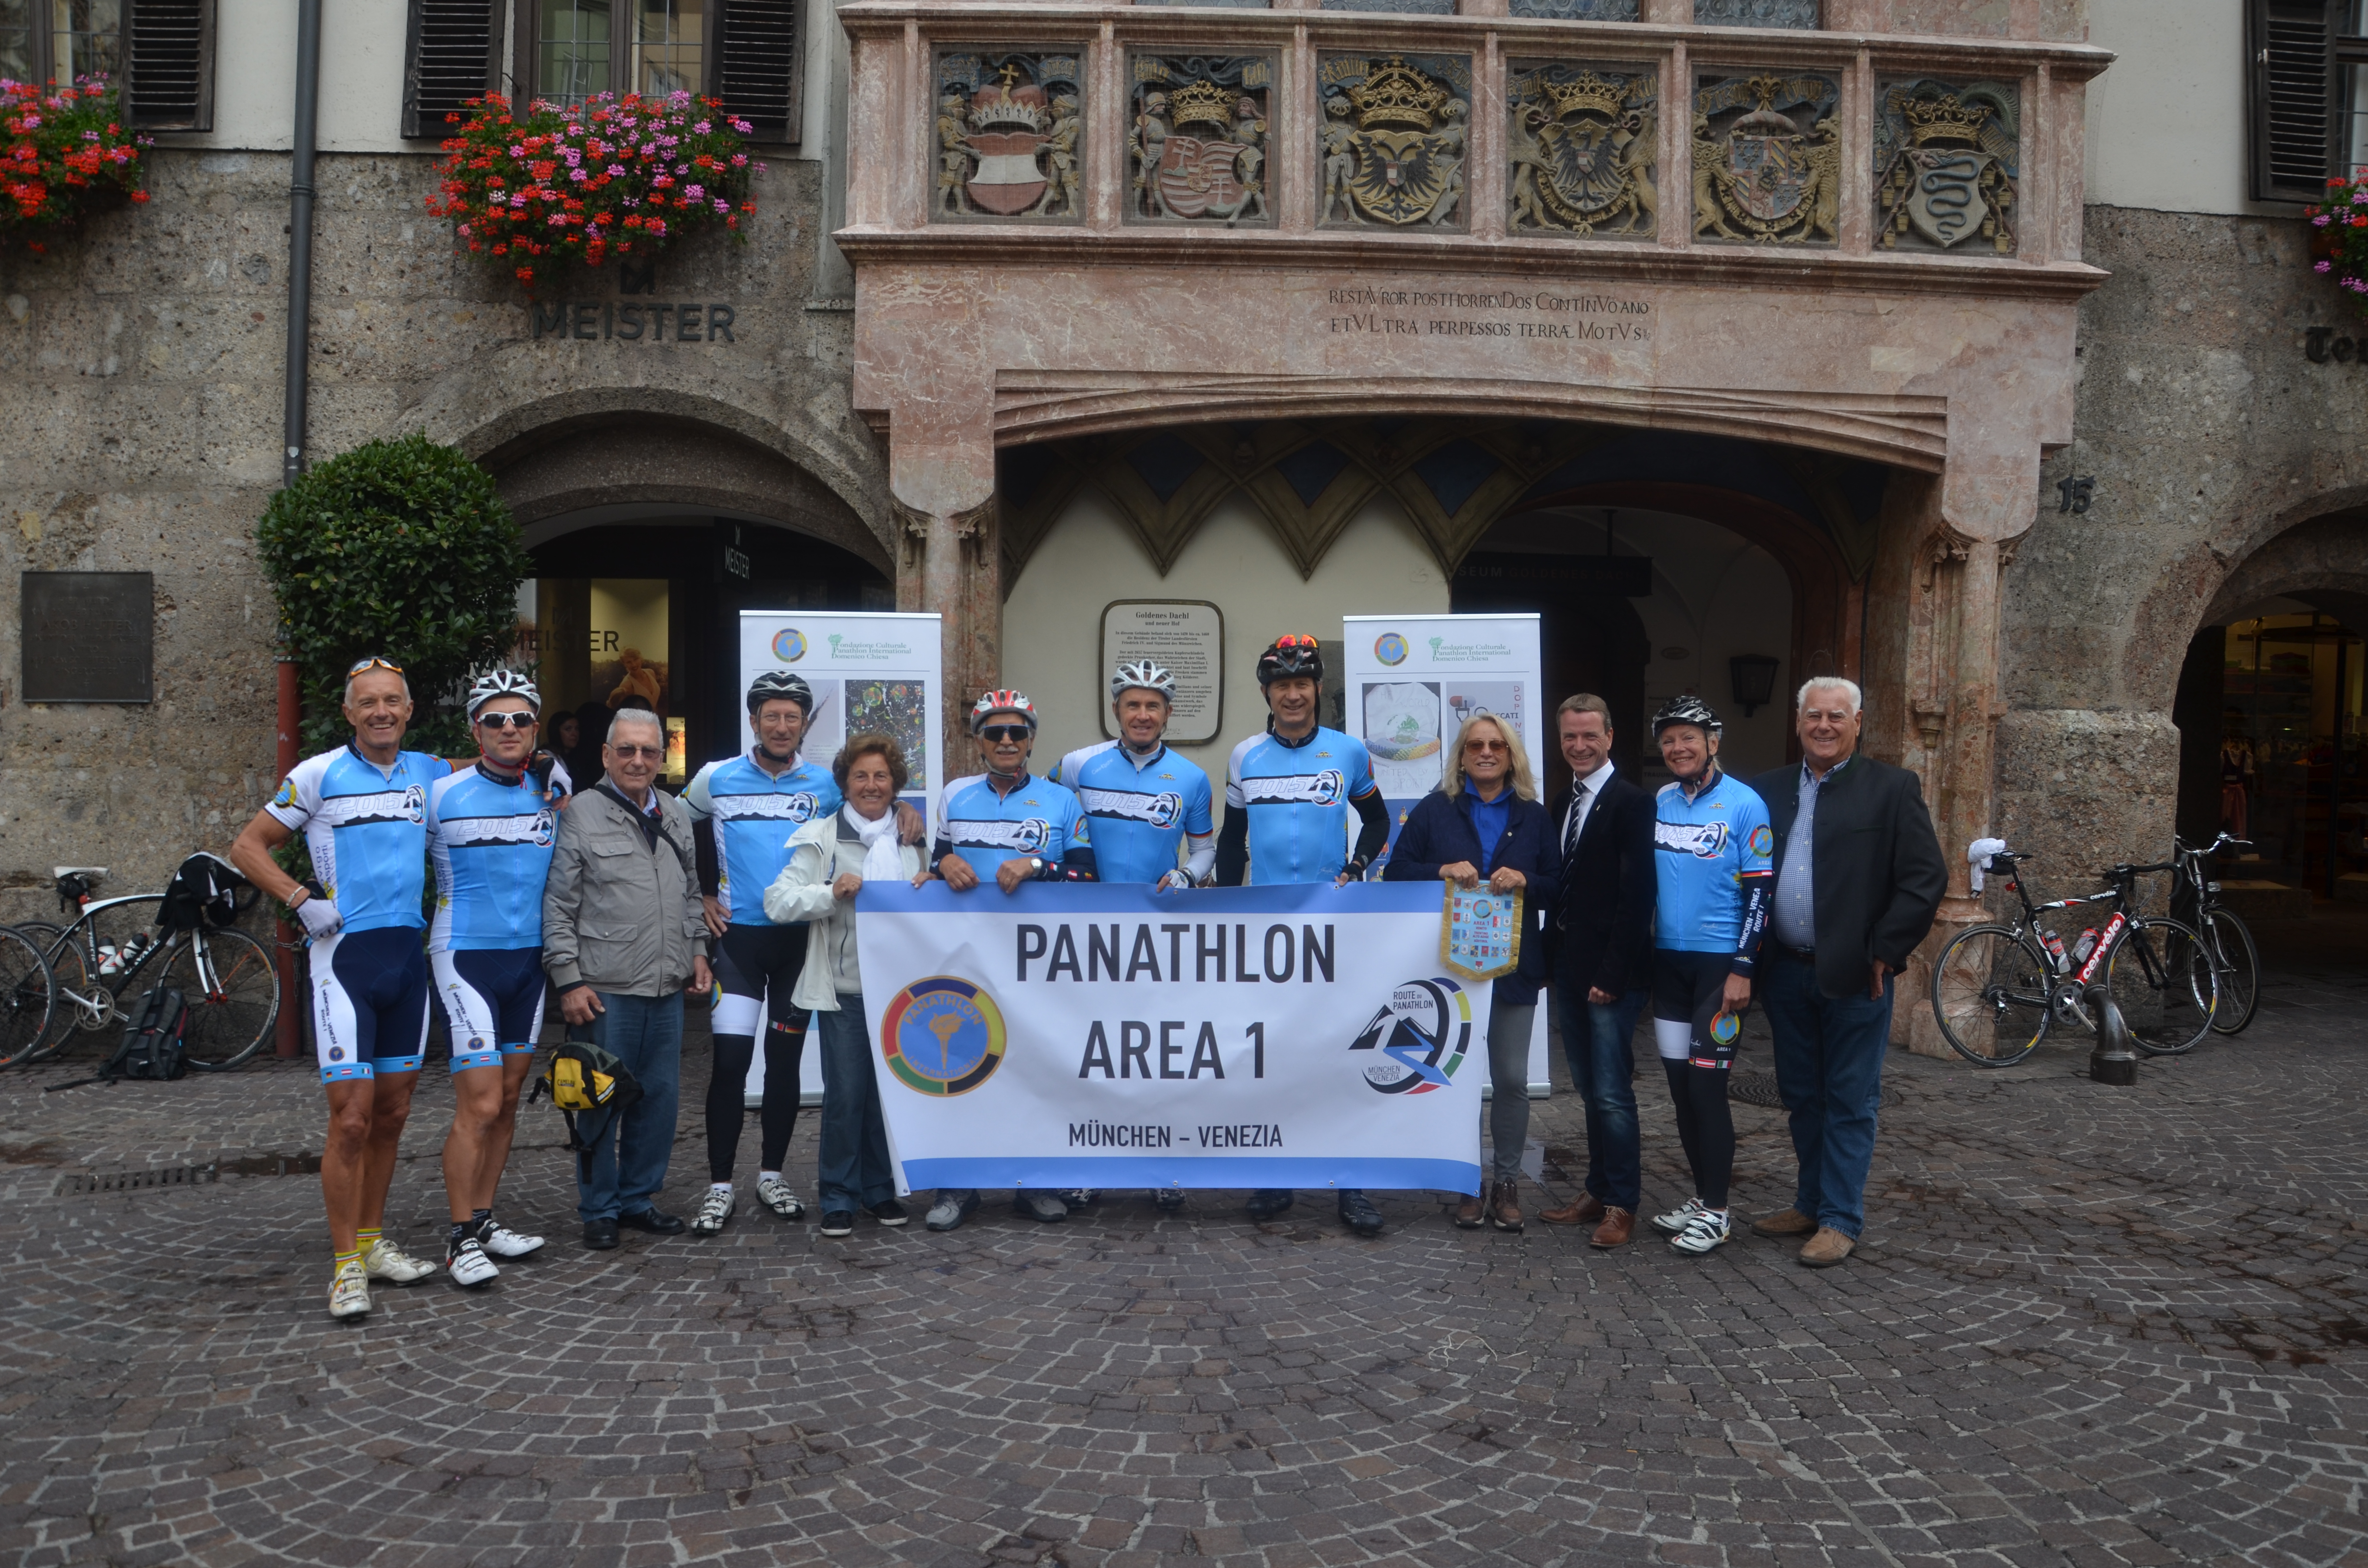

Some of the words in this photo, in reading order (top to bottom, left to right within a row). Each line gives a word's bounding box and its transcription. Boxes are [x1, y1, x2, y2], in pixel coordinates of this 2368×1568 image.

[1620, 302, 1649, 314] ANO
[532, 302, 736, 343] MEISTER
[1430, 320, 1510, 336] PERPESSOS
[2058, 474, 2095, 512] 15
[725, 544, 749, 580] MEISTER
[1459, 566, 1502, 577] SEUM
[1509, 567, 1588, 580] GOLDENES
[1376, 769, 1406, 777] UNITED
[1247, 777, 1308, 795] 2015
[334, 793, 401, 816] 2015
[724, 795, 787, 811] 2015
[1087, 790, 1149, 809] 2015
[456, 817, 530, 836] 2015
[953, 822, 1013, 838] 2015
[2090, 890, 2116, 900] cervélo
[1753, 909, 1764, 932] ROUTE
[1739, 917, 1753, 949] MÜNCHEN
[1016, 924, 1335, 983] PANATHLON
[2083, 919, 2121, 980] cervélo
[453, 992, 467, 1015] MÜNCHEN
[1393, 1000, 1433, 1010] PANATHLON
[1394, 991, 1416, 1000] ROUTE
[455, 1008, 463, 1023] ROUTE
[903, 995, 984, 1026] PANATHLON
[1079, 1020, 1225, 1080] AREA
[1245, 1021, 1265, 1079] 1
[908, 1055, 981, 1077] INTERNATIONAL
[1368, 1065, 1400, 1074] MÜNCHEN
[1373, 1074, 1400, 1082] VENEZIA
[1069, 1122, 1171, 1148] MÜNCHEN
[1198, 1124, 1283, 1148] VENEZIA
